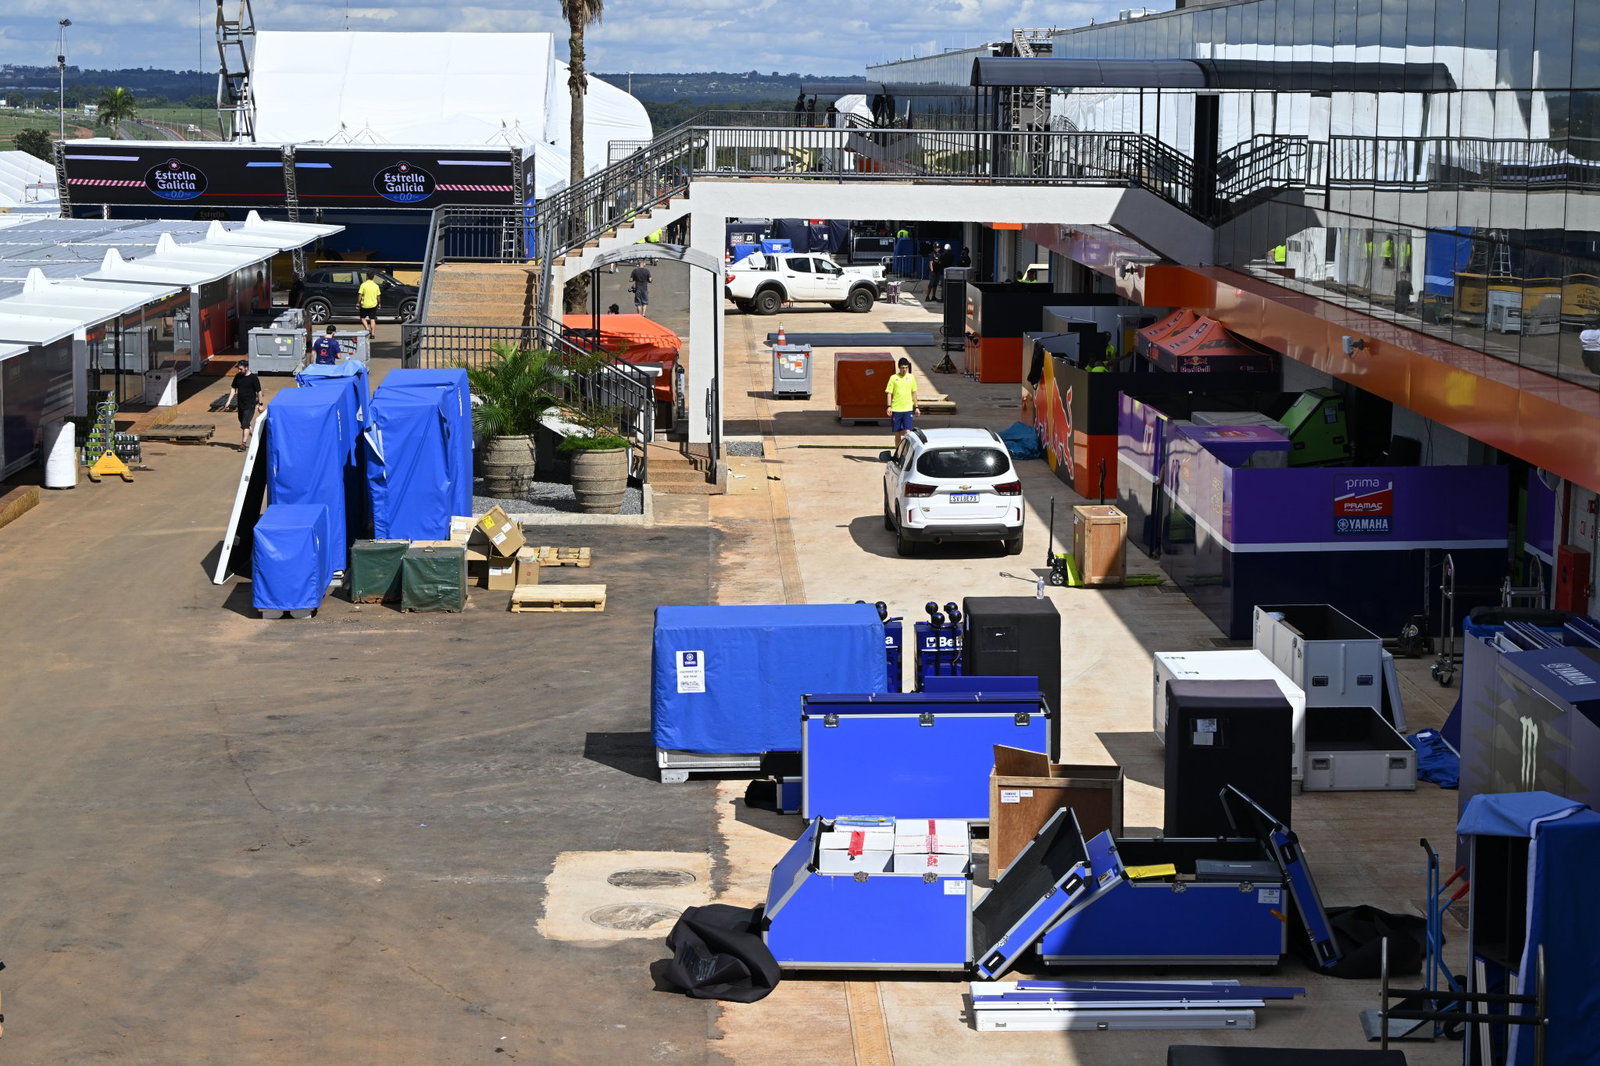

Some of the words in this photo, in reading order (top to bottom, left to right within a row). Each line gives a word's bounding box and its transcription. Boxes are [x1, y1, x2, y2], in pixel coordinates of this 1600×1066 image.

[155, 170, 196, 180] Estrella
[384, 173, 425, 182] Estrella
[157, 180, 196, 190] Galicia
[386, 182, 424, 192] Galicia
[1345, 479, 1380, 490] prima
[1344, 502, 1383, 511] PRAMAC
[1349, 518, 1388, 530] YAMAHA
